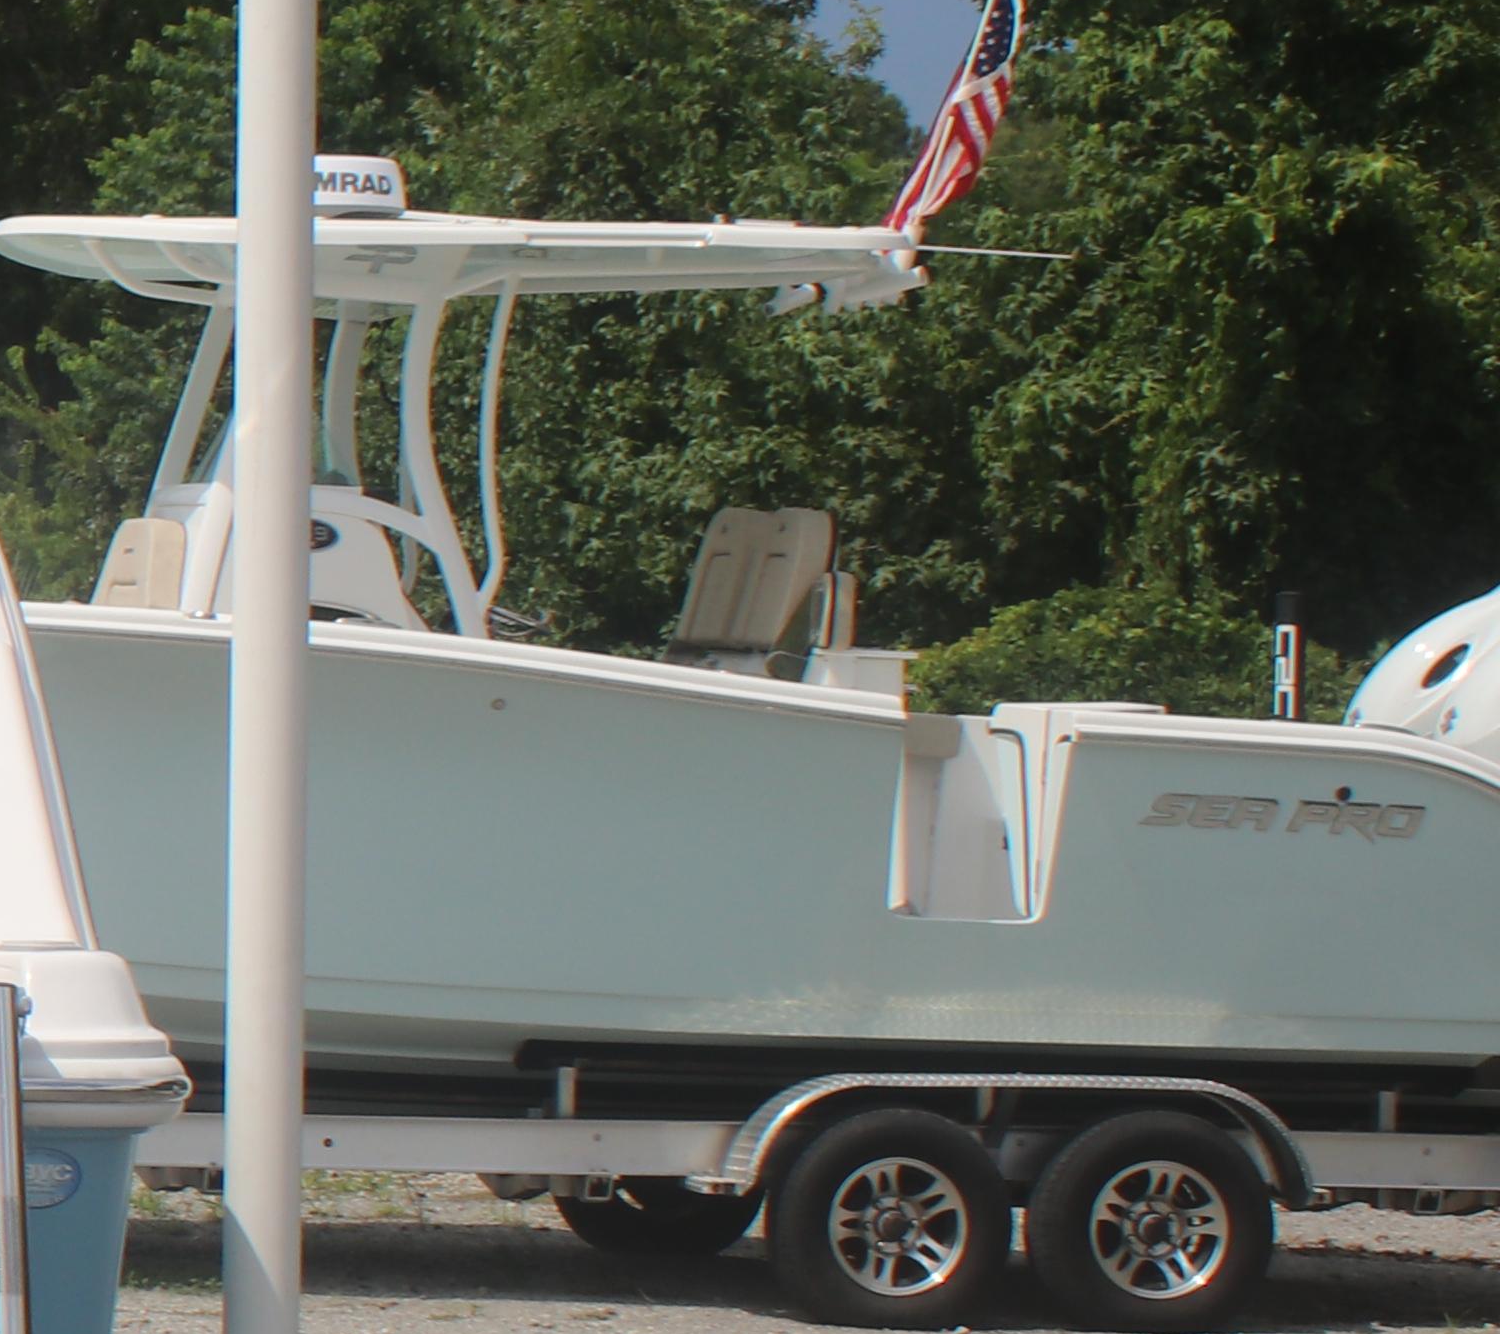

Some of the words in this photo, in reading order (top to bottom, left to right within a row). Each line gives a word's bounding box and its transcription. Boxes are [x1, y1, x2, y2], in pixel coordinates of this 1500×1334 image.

[315, 171, 393, 196] MRAD
[1139, 793, 1279, 833] SEA
[1286, 799, 1427, 843] PRO
